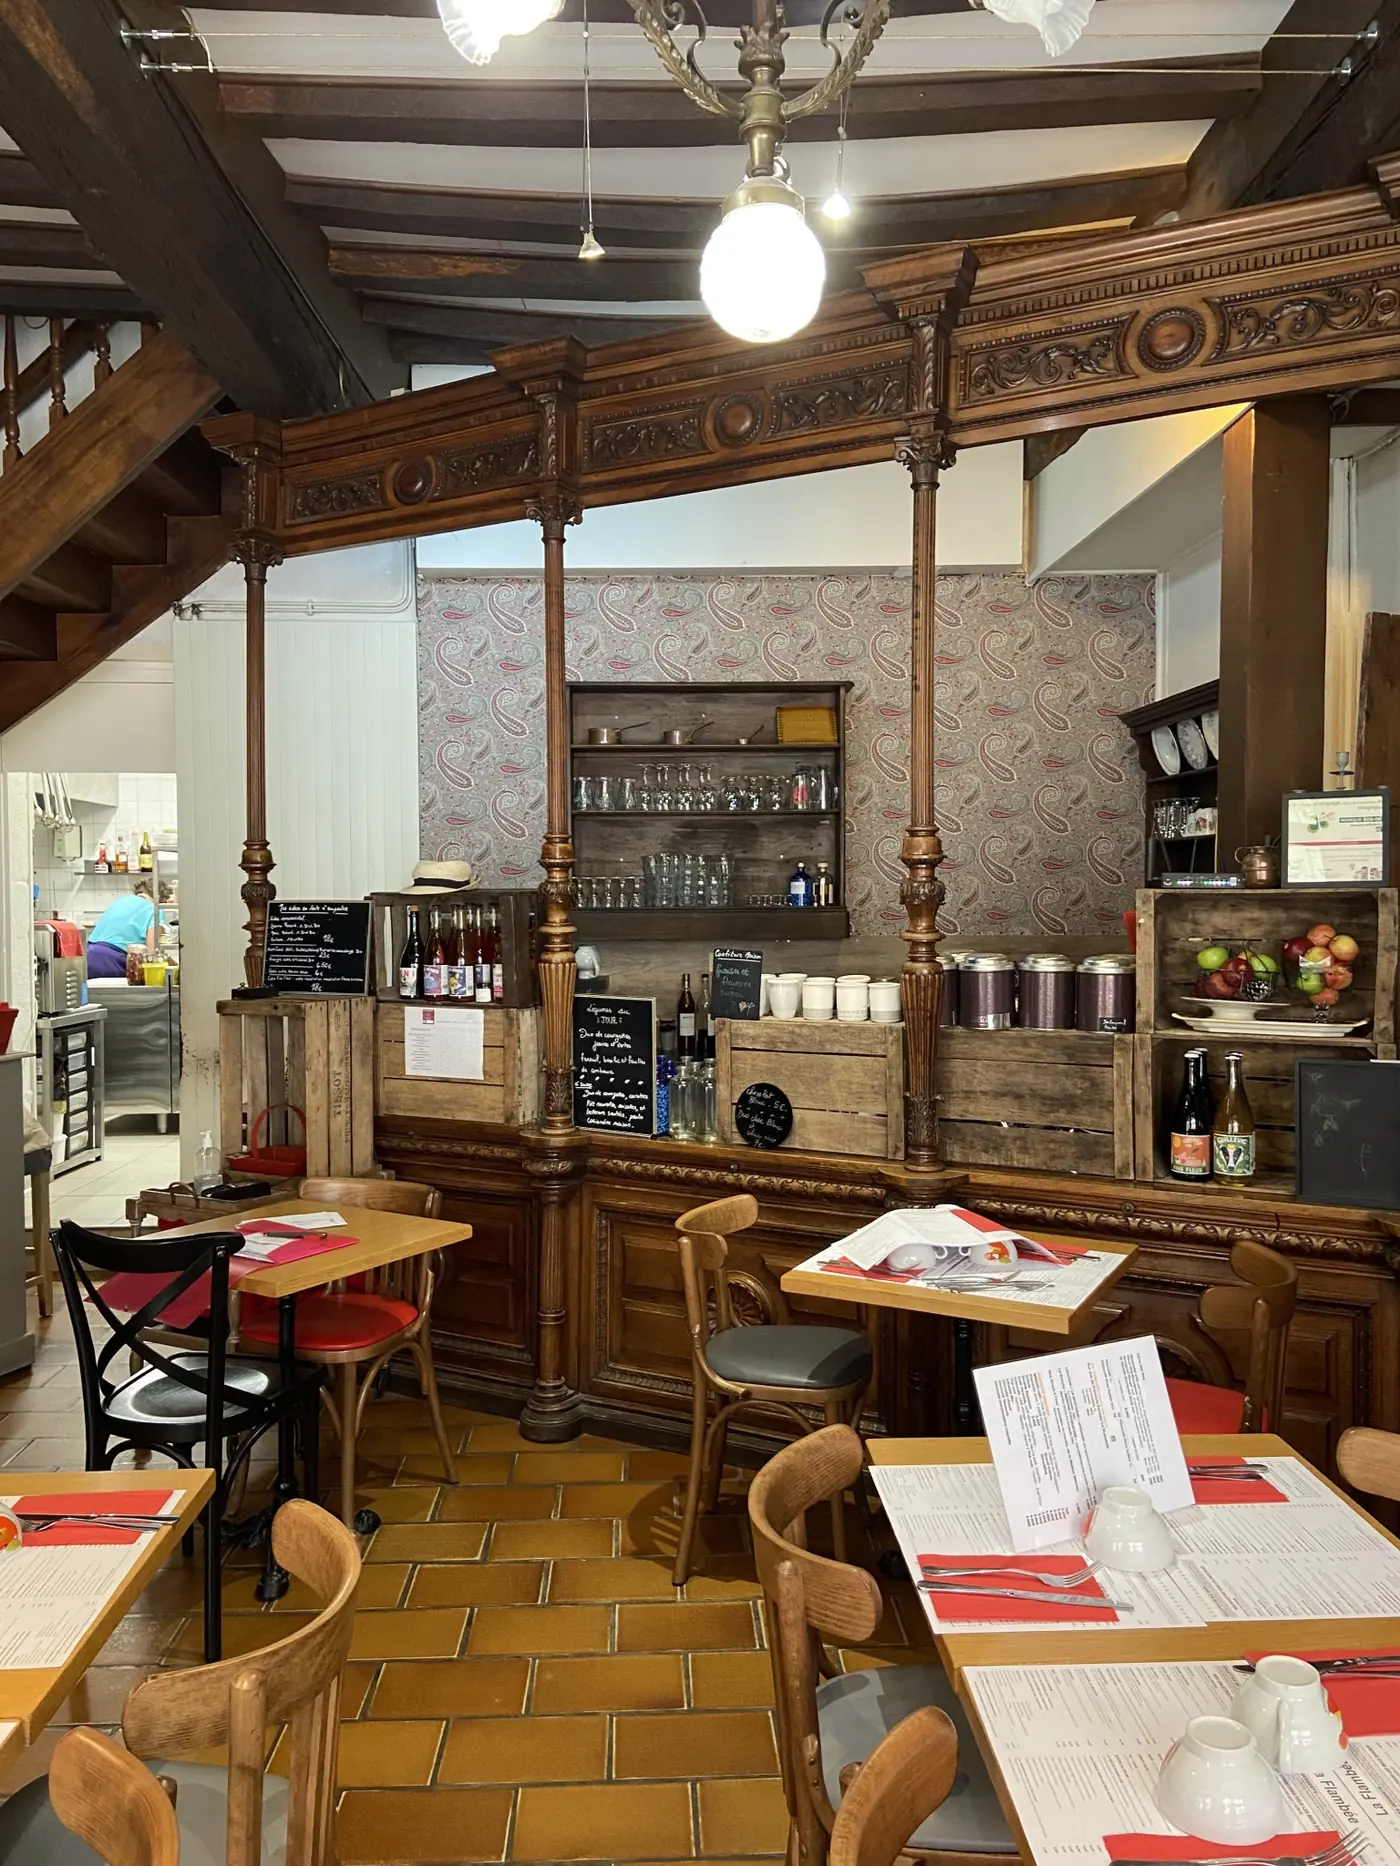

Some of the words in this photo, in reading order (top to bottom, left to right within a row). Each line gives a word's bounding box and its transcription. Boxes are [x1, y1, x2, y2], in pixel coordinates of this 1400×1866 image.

[333, 1071, 342, 1118] TISSOT
[1319, 1779, 1359, 1824] Flambée
[1342, 1760, 1377, 1801] Flambé
[1372, 1802, 1389, 1816] La
